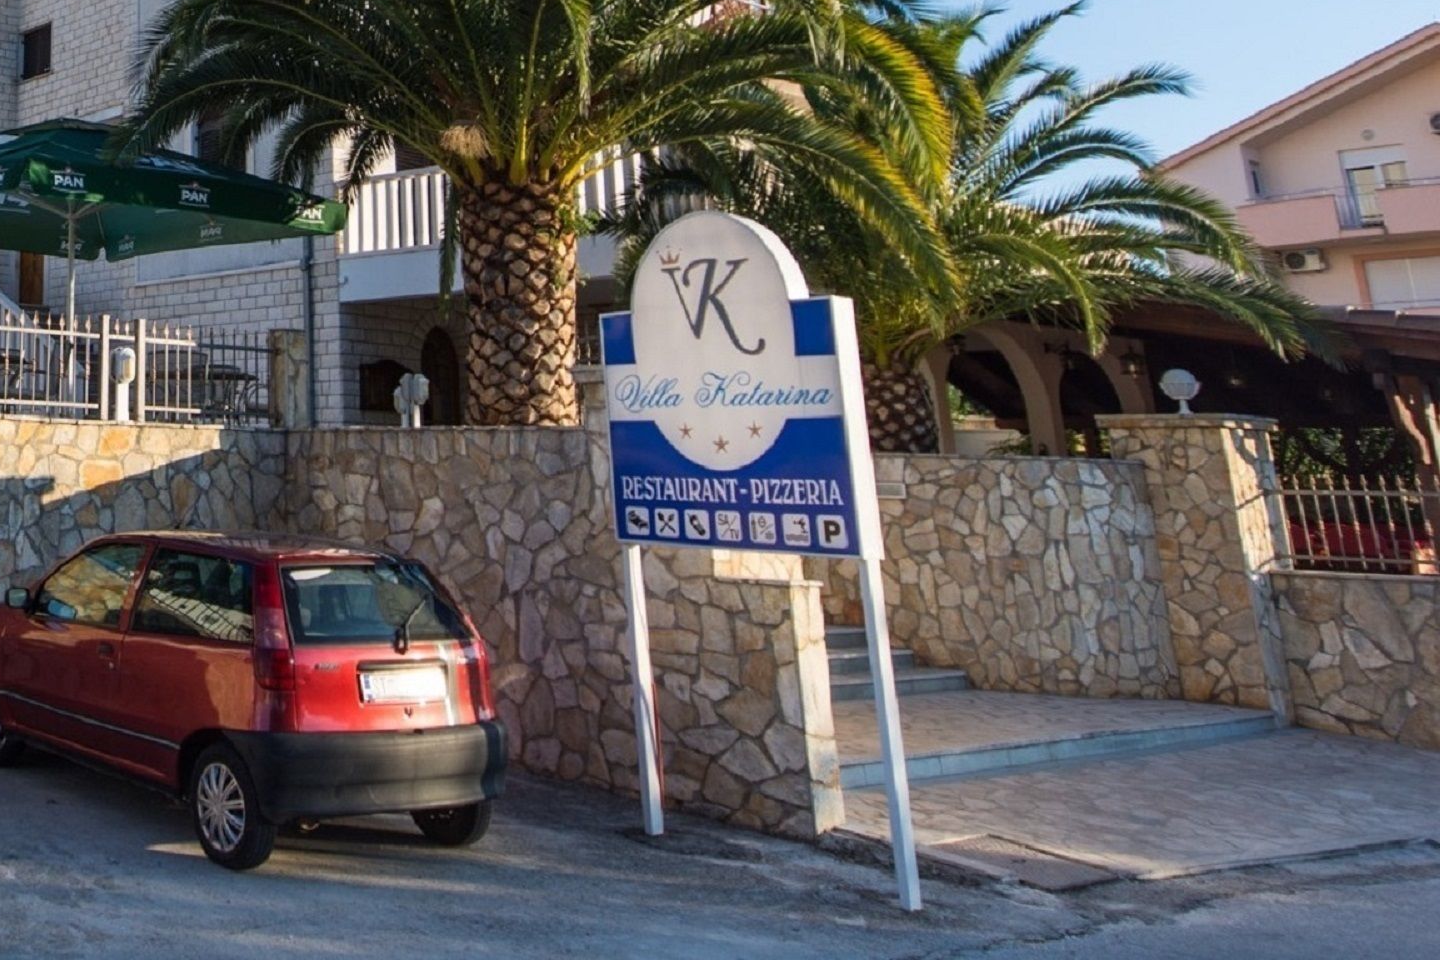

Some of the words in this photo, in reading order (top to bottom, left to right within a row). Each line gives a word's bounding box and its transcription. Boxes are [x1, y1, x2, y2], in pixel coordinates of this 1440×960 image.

[54, 174, 85, 189] PAN
[180, 189, 208, 204] PAN
[615, 374, 684, 414] Villa
[695, 371, 833, 408] Katarina
